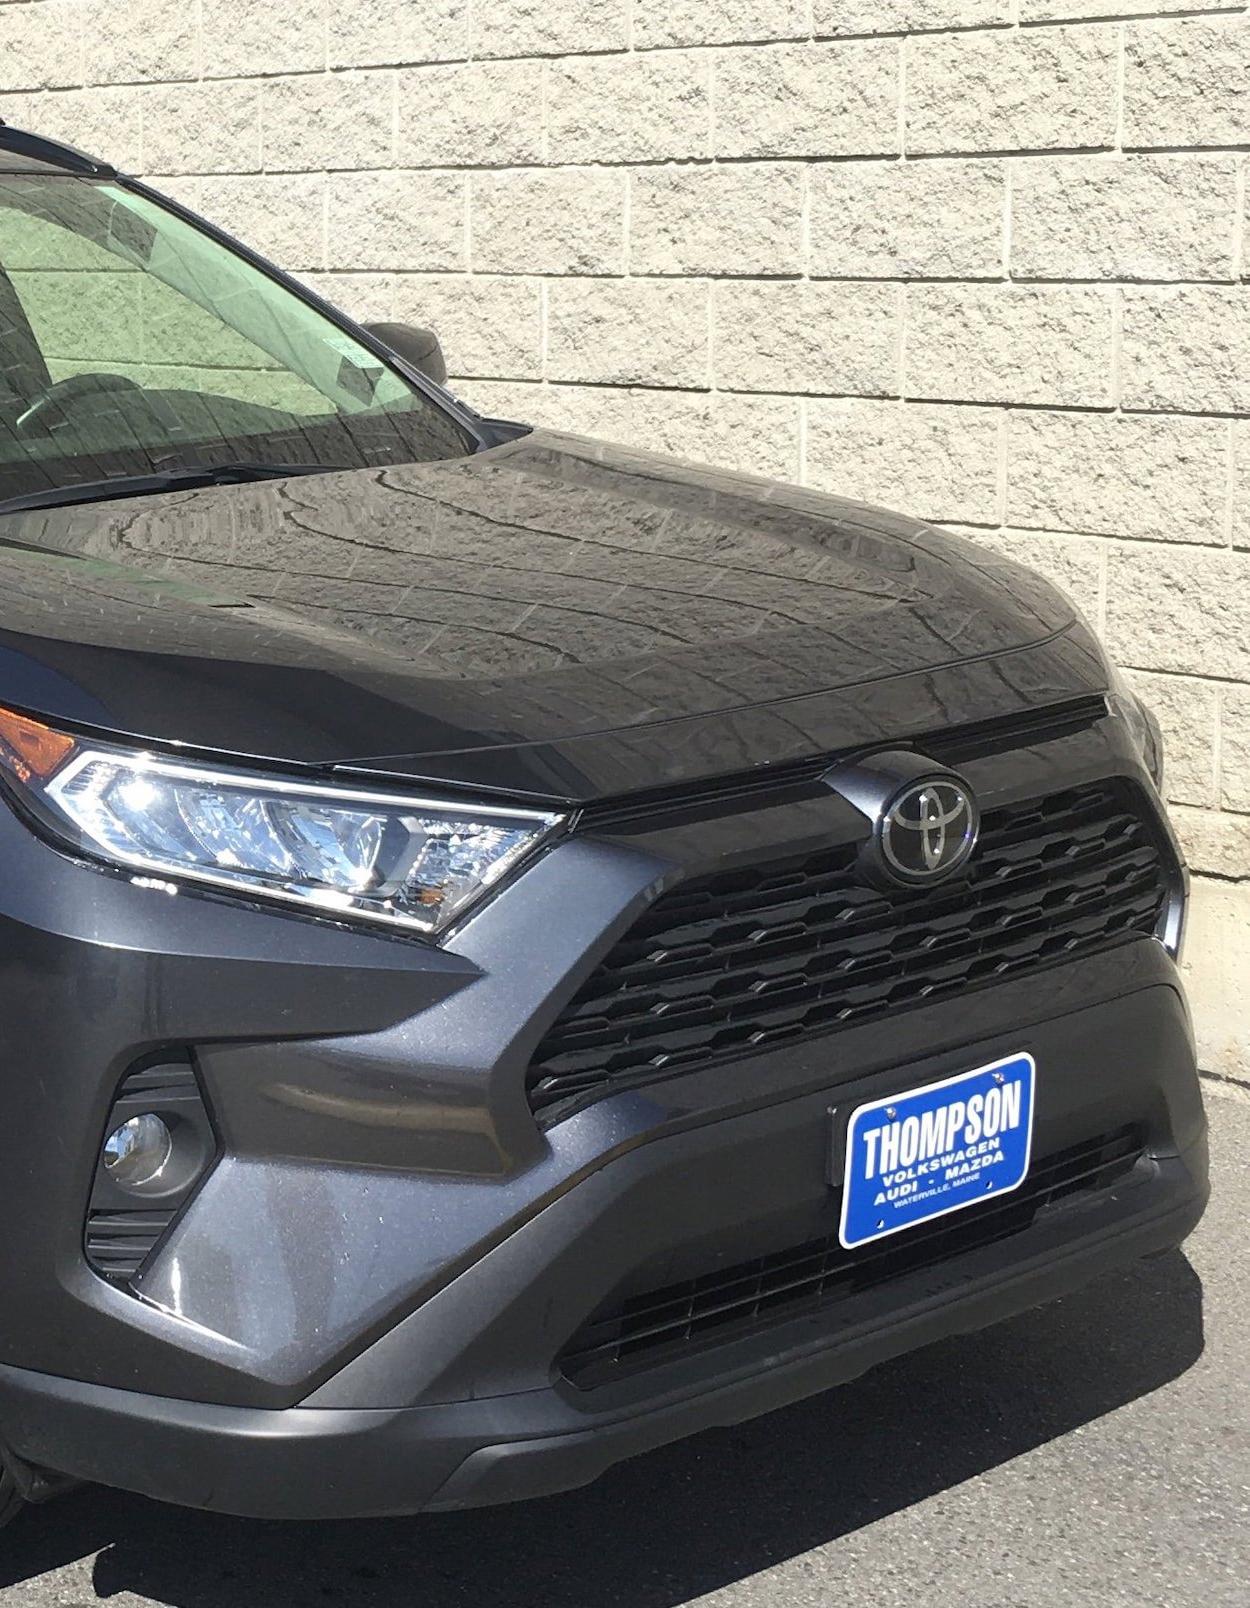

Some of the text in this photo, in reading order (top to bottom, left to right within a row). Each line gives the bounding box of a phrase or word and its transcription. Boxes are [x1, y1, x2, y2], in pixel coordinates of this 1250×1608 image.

[863, 1080, 1021, 1180] THOMPSON
[874, 1181, 918, 1206] AUDI
[945, 1150, 1004, 1180] MAZDA
[882, 1137, 1000, 1187] VOLKSWAGEN
[893, 1172, 980, 1208] WATERVILLE, MAINE
